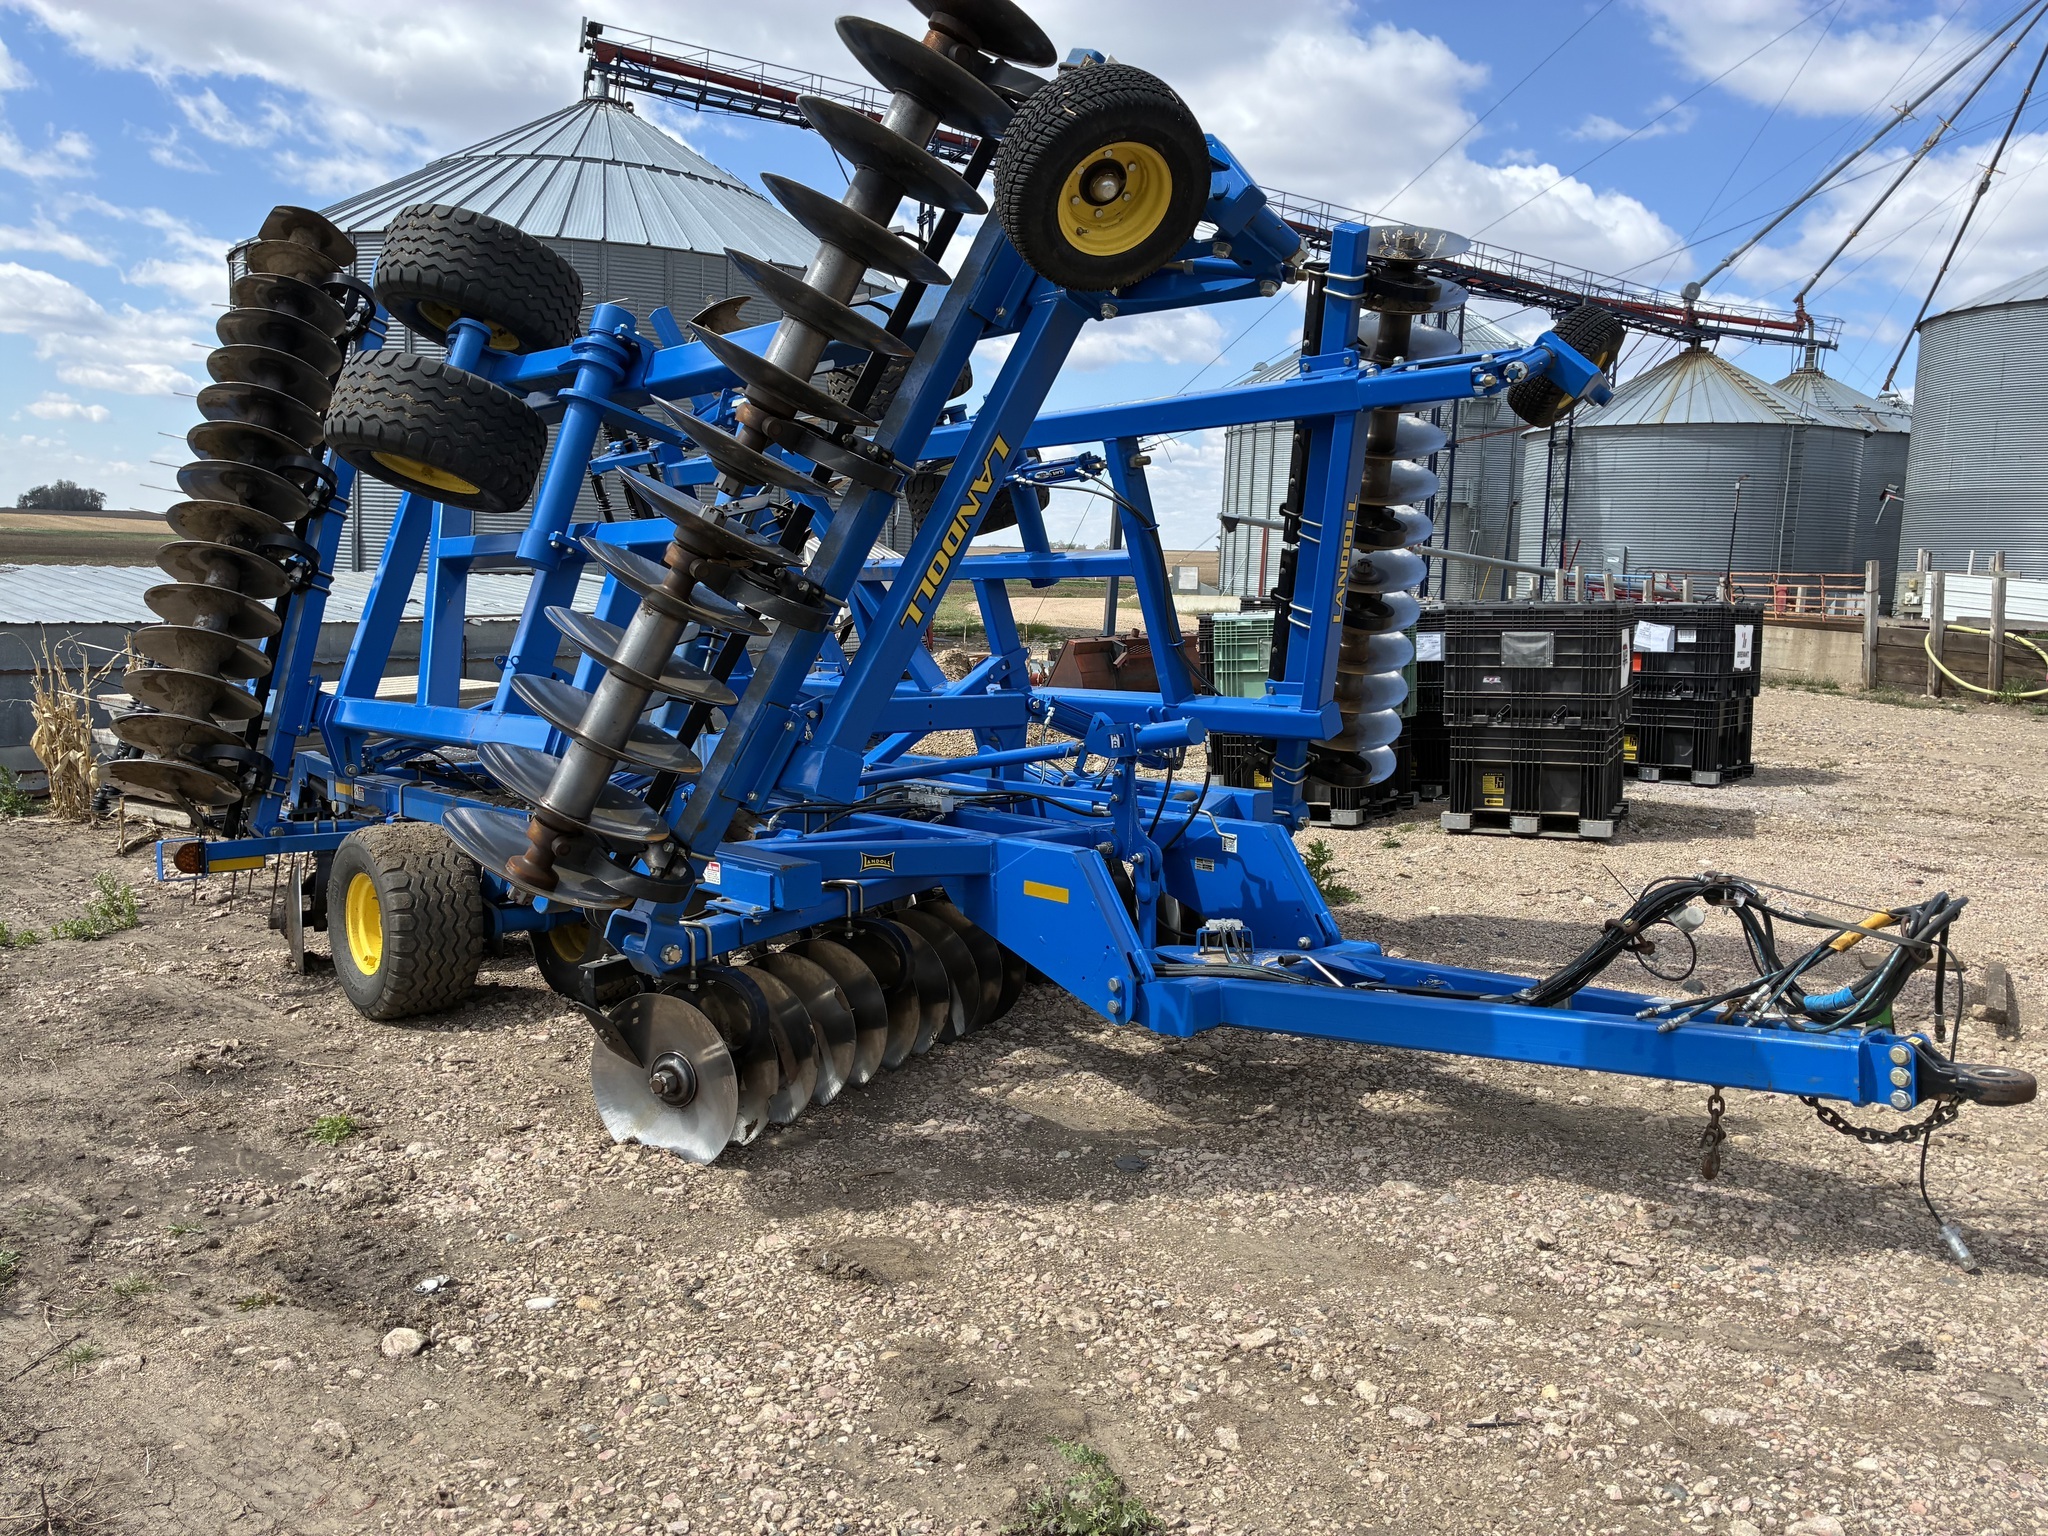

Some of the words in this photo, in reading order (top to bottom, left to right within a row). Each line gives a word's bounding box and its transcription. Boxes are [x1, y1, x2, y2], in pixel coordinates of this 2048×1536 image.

[900, 434, 1011, 629] LANDOLL
[1332, 493, 1358, 624] LANDOLL
[863, 856, 891, 868] LANDOLL
